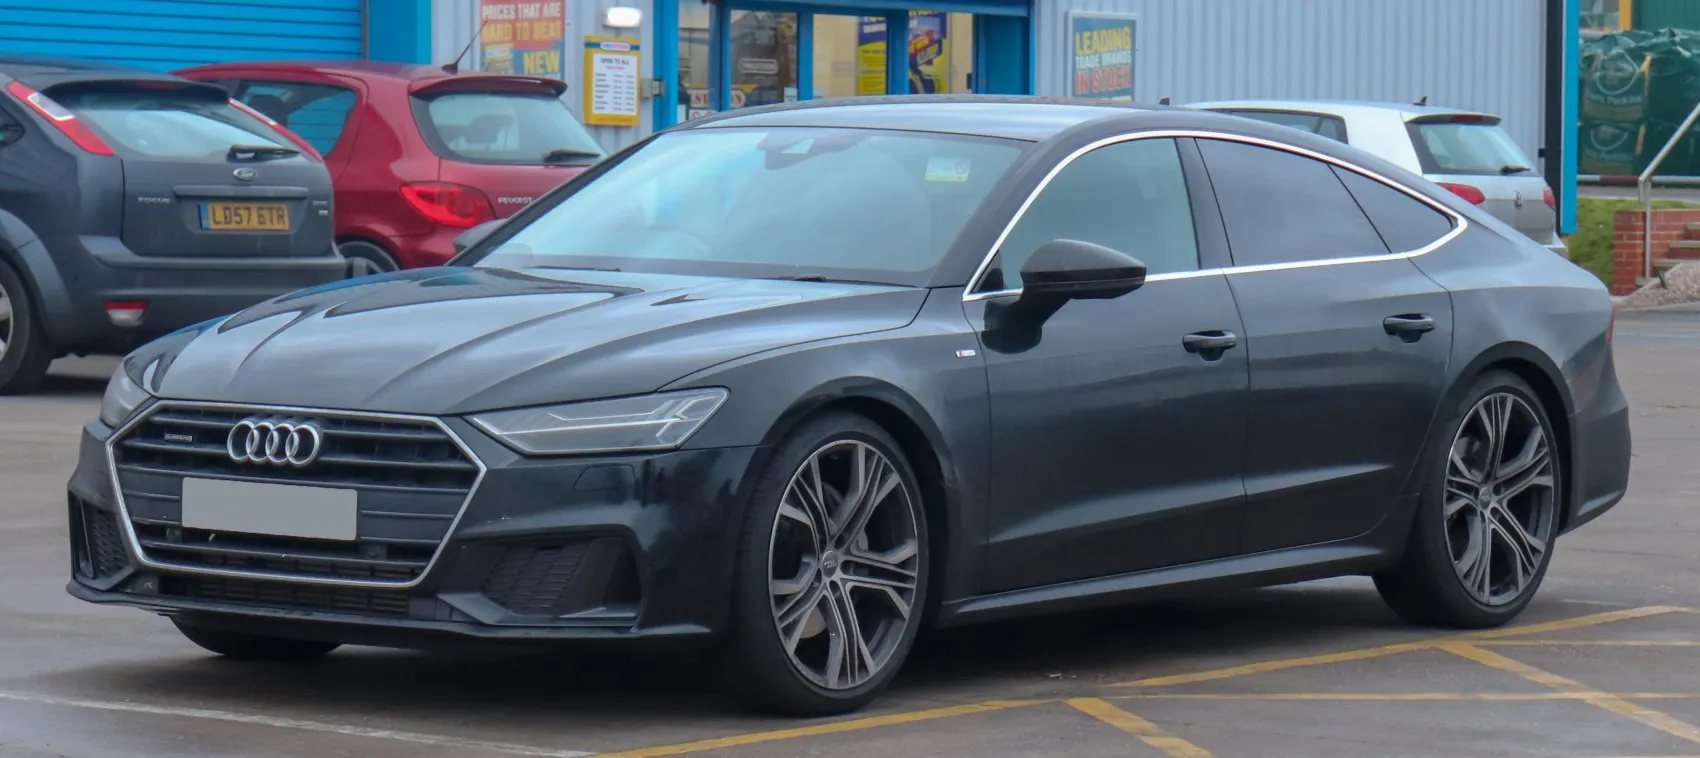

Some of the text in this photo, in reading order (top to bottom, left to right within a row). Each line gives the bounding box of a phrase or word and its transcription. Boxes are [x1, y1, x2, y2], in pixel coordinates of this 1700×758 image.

[482, 2, 561, 19] PRICES THAT ARE
[1075, 26, 1132, 56] LEADING
[523, 50, 560, 76] NEW
